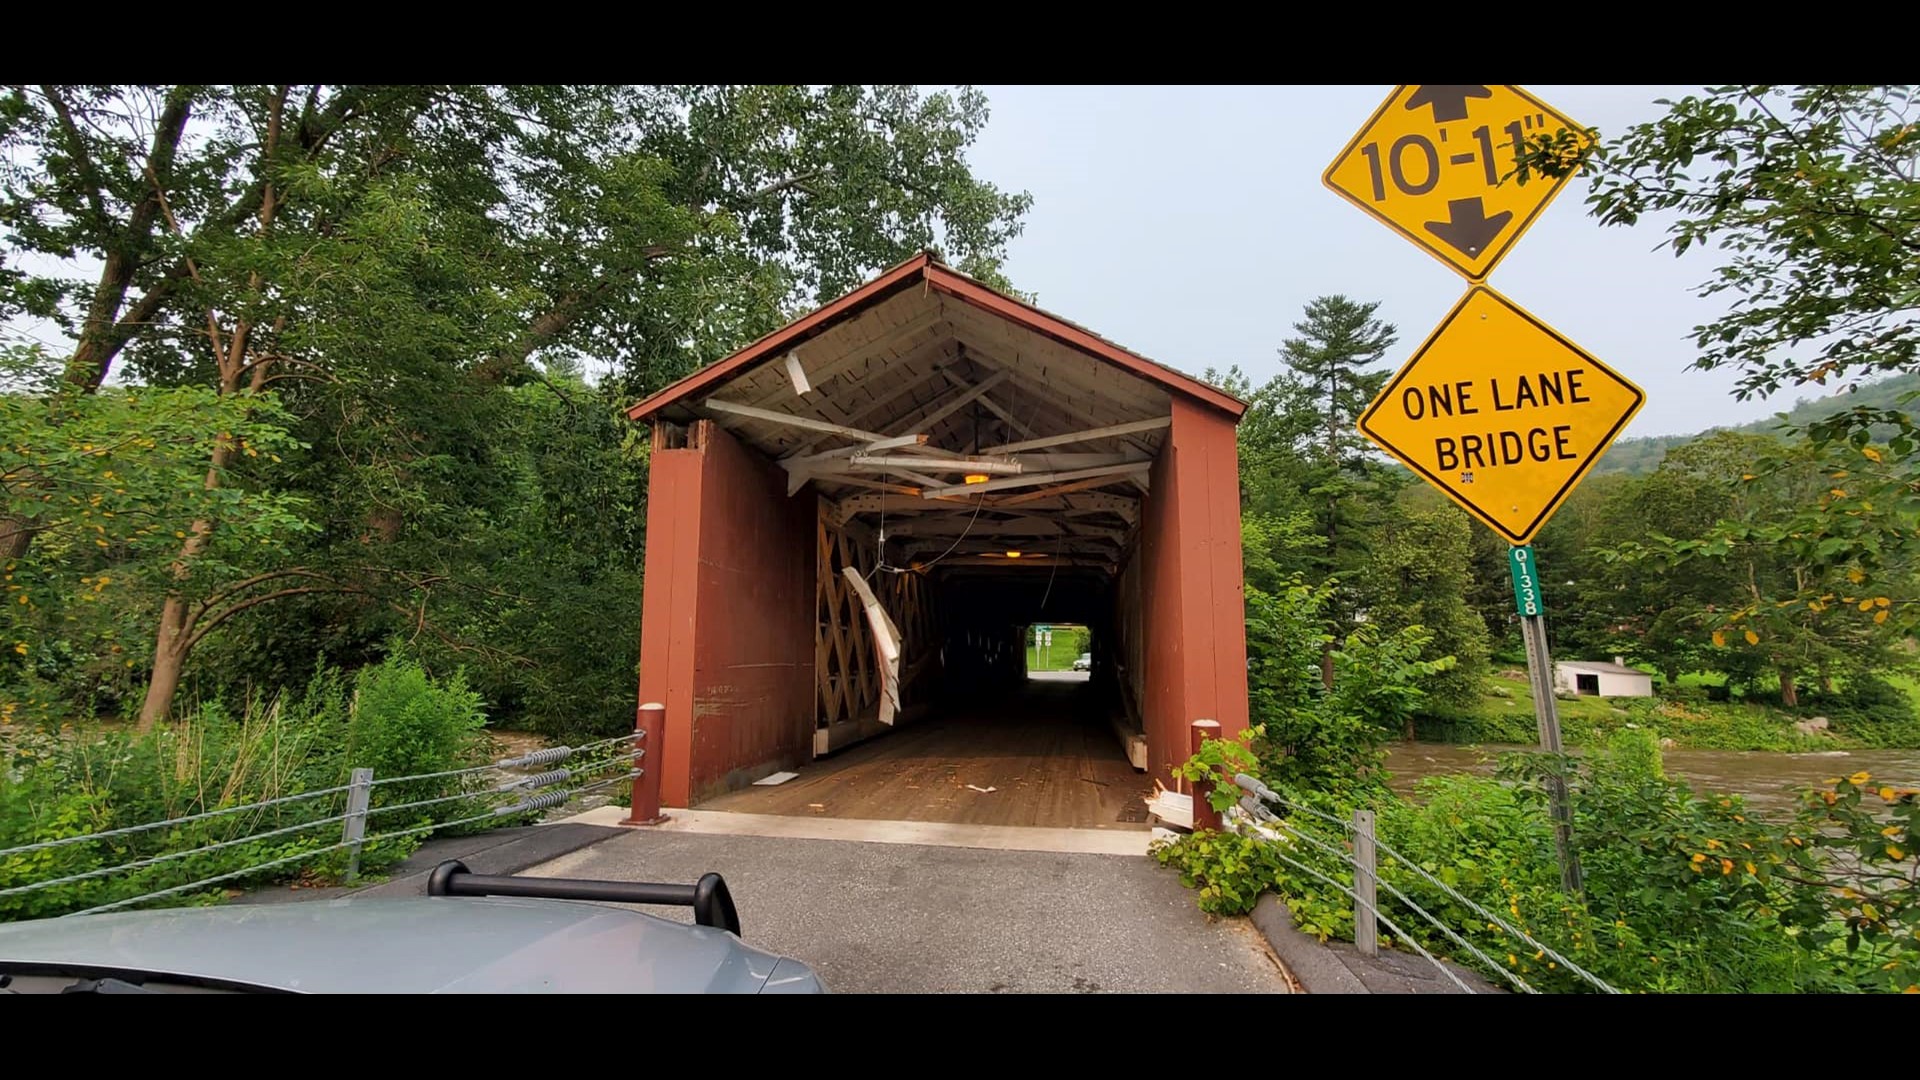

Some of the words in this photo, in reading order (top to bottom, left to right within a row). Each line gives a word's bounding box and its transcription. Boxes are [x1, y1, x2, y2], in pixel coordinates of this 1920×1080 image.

[1402, 381, 1479, 421] ONE
[1491, 369, 1590, 412] LANE
[1435, 425, 1577, 471] BRIDGE
